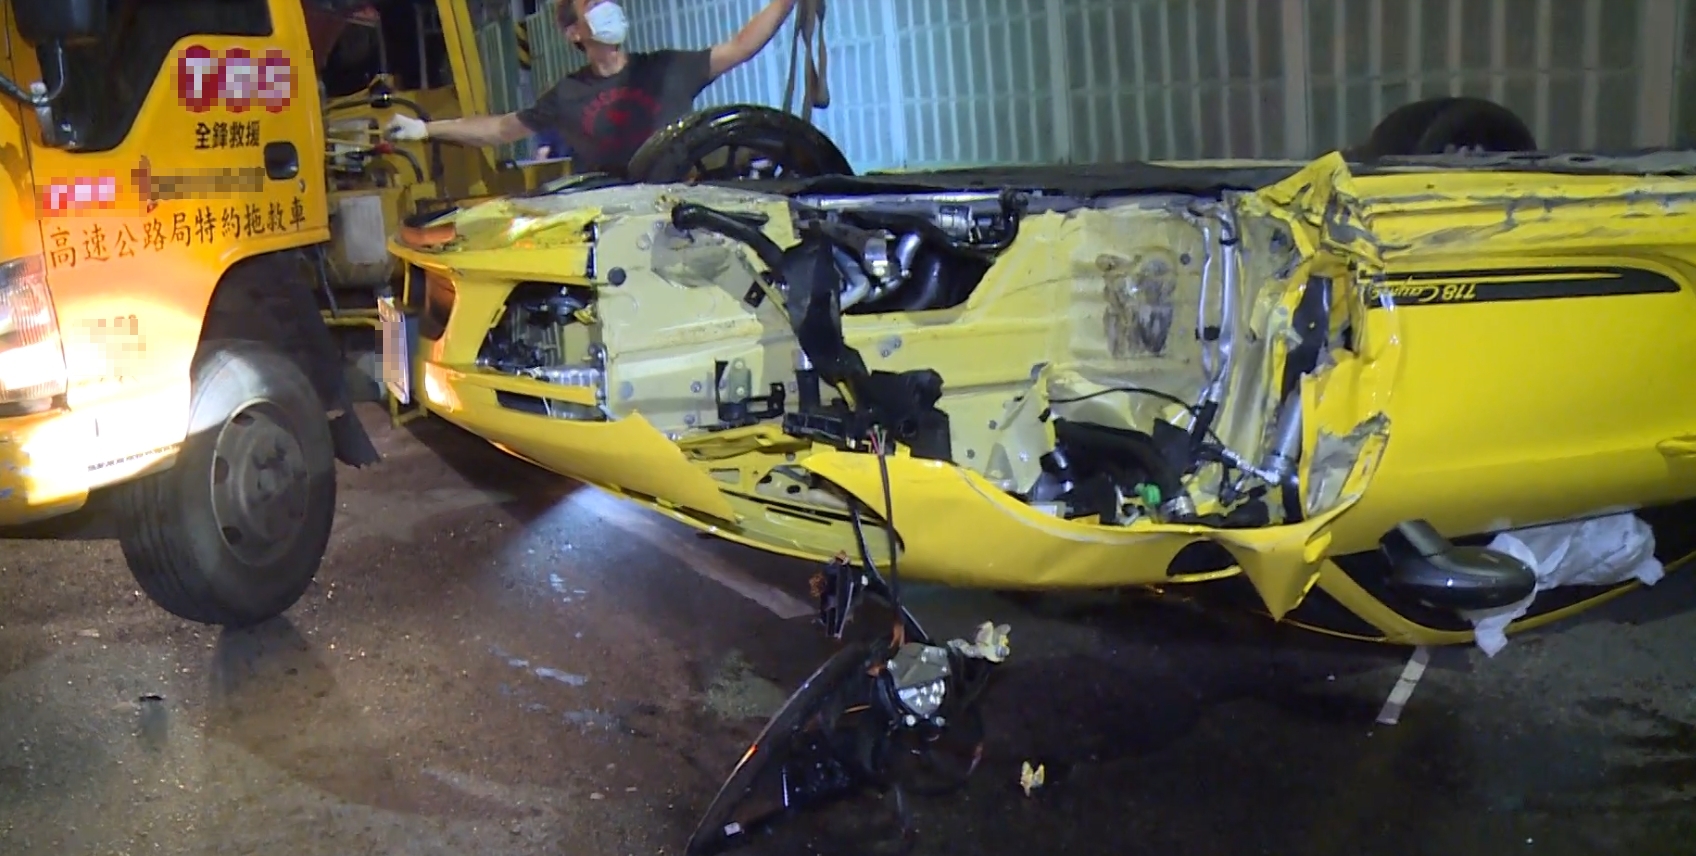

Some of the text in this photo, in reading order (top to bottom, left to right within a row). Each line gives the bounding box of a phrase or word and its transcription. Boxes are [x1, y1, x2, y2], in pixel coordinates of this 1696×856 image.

[194, 120, 261, 150] 全鋒救援
[49, 195, 307, 269] 高速公路局特約拖救車
[1370, 275, 1476, 302] 718 Caym
